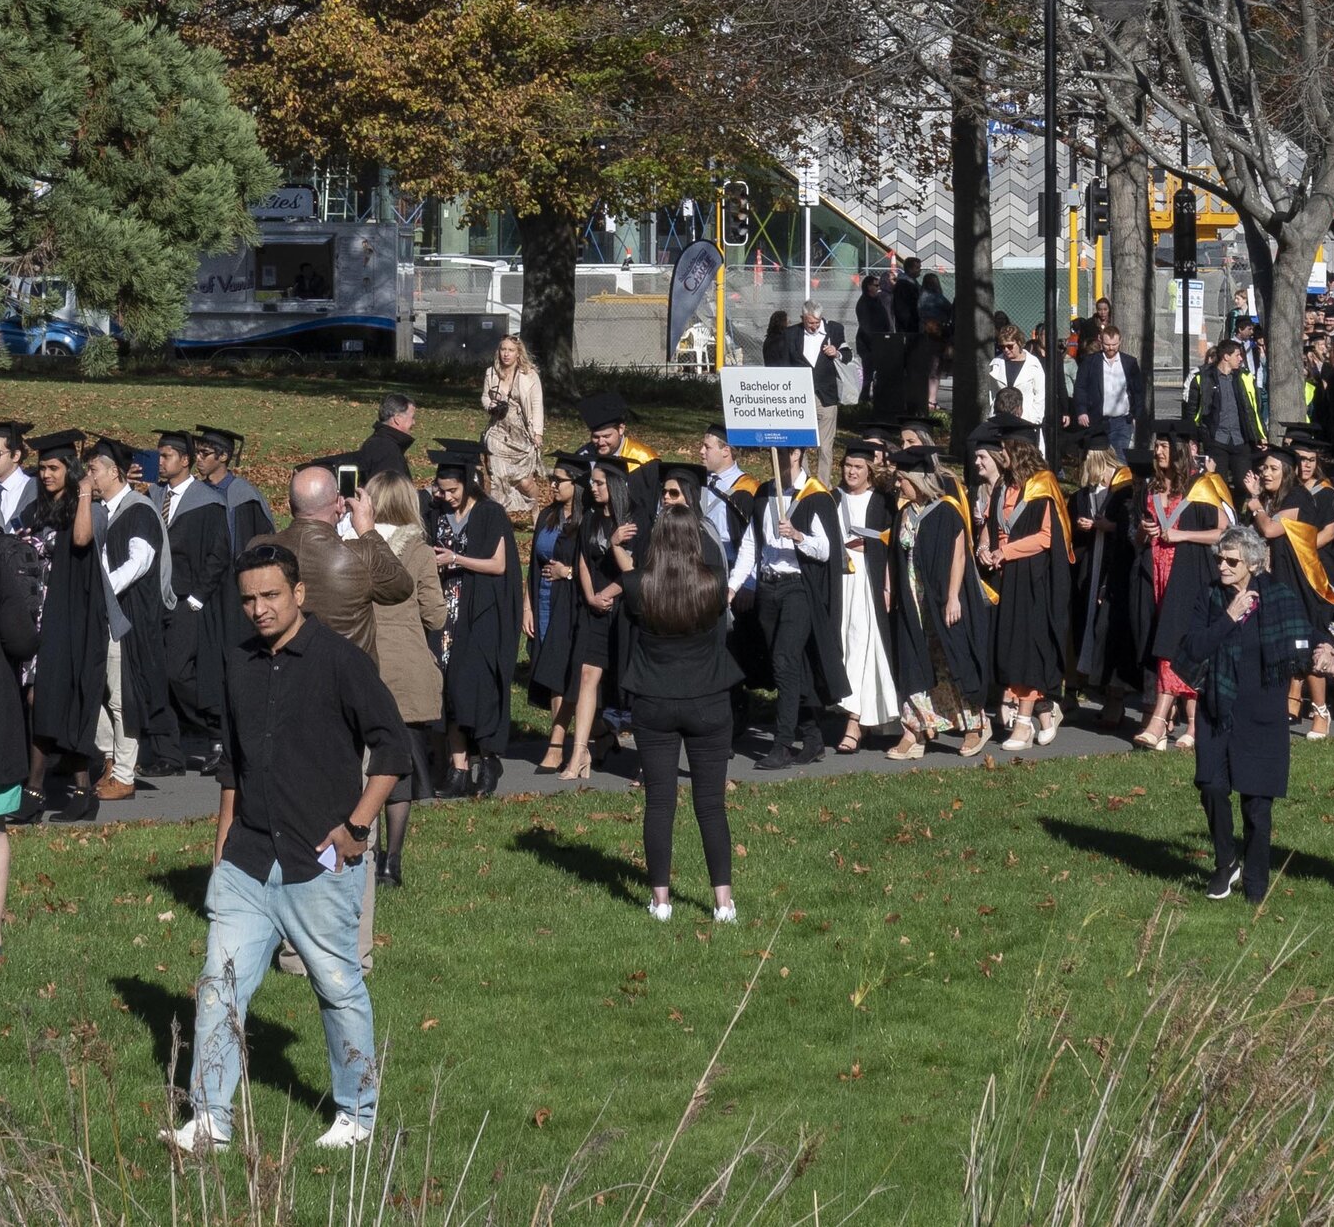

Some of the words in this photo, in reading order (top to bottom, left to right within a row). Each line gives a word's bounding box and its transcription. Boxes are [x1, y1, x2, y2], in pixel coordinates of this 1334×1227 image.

[740, 381, 780, 391] Bachelor
[782, 381, 791, 390] of
[729, 394, 787, 406] Agribusiness
[789, 394, 807, 404] and
[734, 407, 756, 417] Food
[758, 408, 804, 419] Marketing
